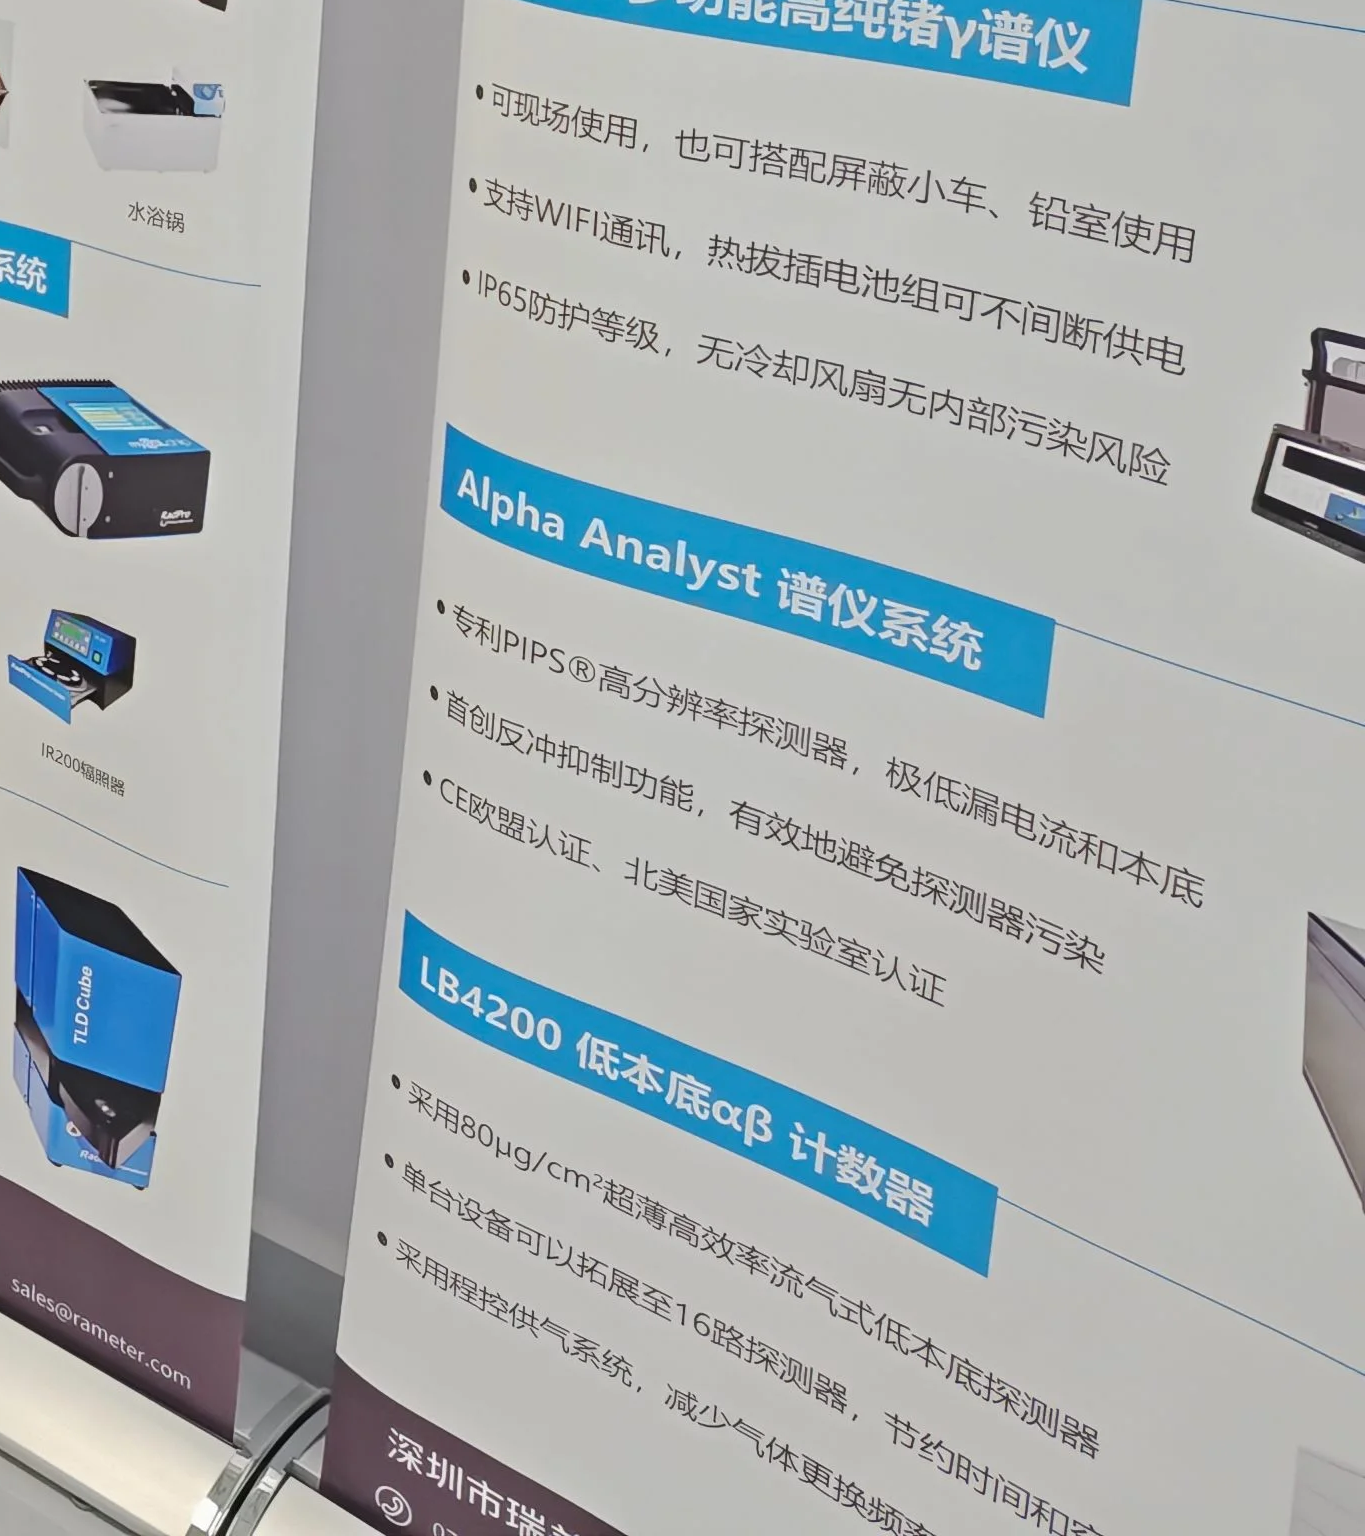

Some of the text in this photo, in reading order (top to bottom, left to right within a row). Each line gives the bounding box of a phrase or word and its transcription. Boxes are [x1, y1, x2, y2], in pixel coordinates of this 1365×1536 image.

[127, 200, 186, 234] 水浴锅
[491, 82, 1197, 265] 可现场使用，也可搭配屏蔽小车、铅室使用
[477, 269, 1172, 487] IP65防护等级，无冷却风扇无内部污染风险
[482, 176, 1187, 378] 支持WIFI通讯，热拔插电池组可不间断供电
[456, 466, 985, 673] Alpha Analyst 谱仪系统
[40, 741, 126, 798] IR200辐照器
[445, 689, 1107, 977] 首创反冲抑制功能，有效地避免探测器污染
[439, 776, 948, 1009] CE欧盟认证、北美国家实验室认证
[73, 965, 94, 1045] TLD Cube
[419, 954, 936, 1229] LB4200 低本底αβ 计数器
[10, 1274, 192, 1392] sales@rameter.com
